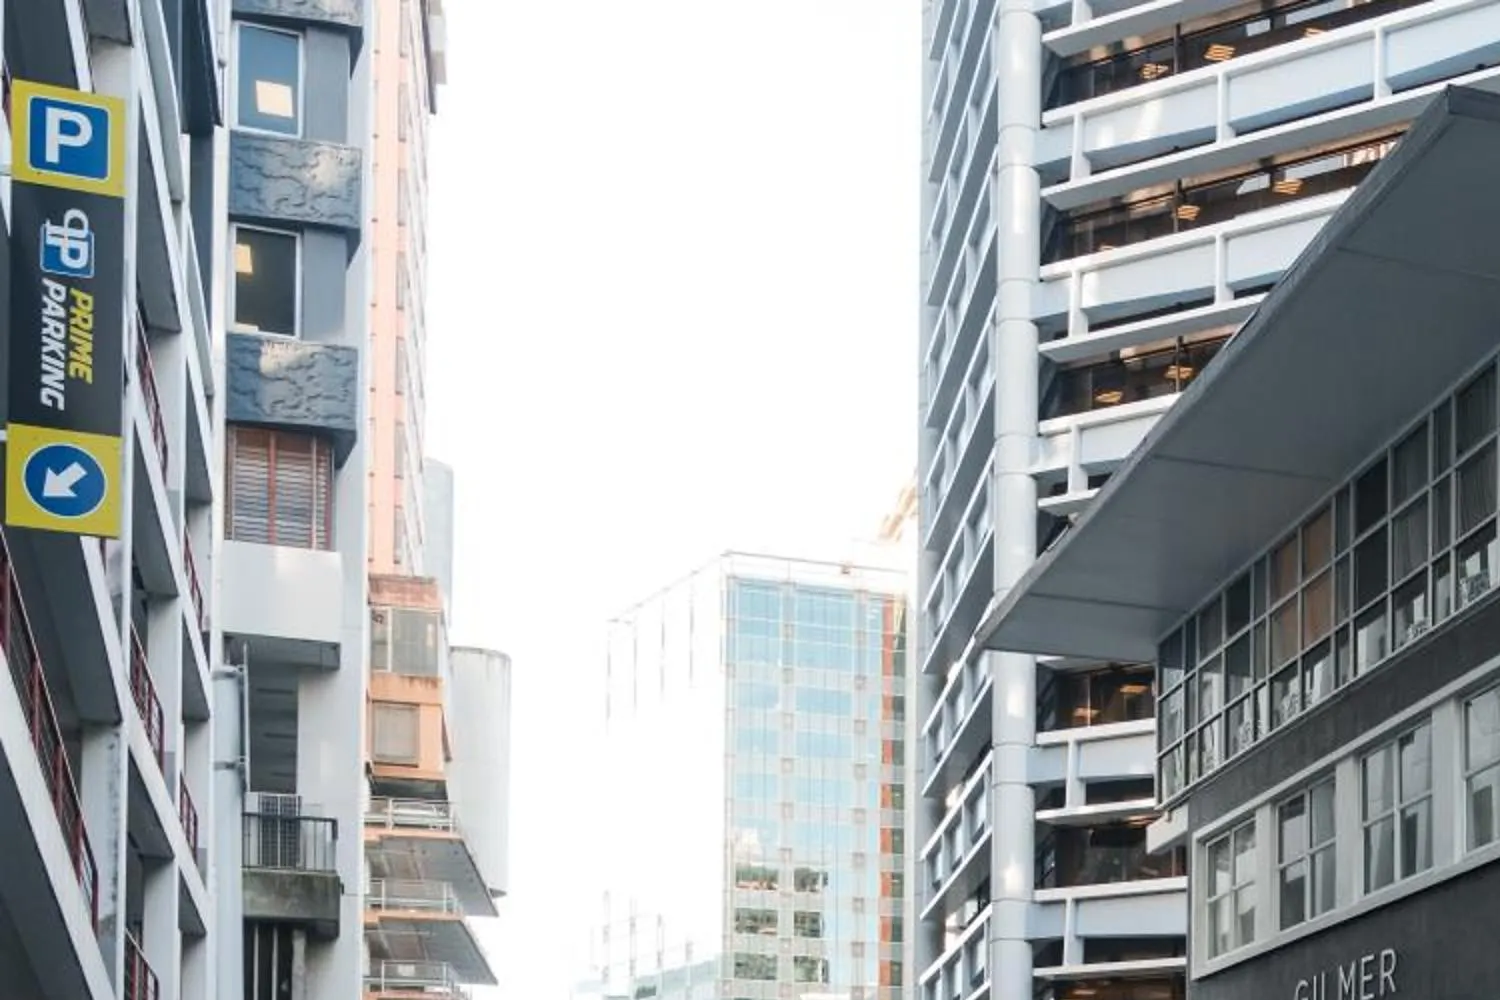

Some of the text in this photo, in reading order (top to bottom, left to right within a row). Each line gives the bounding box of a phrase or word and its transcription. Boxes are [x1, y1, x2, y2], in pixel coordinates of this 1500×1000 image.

[44, 106, 93, 164] P
[40, 277, 66, 411] PARKING
[69, 287, 94, 384] PRIME
